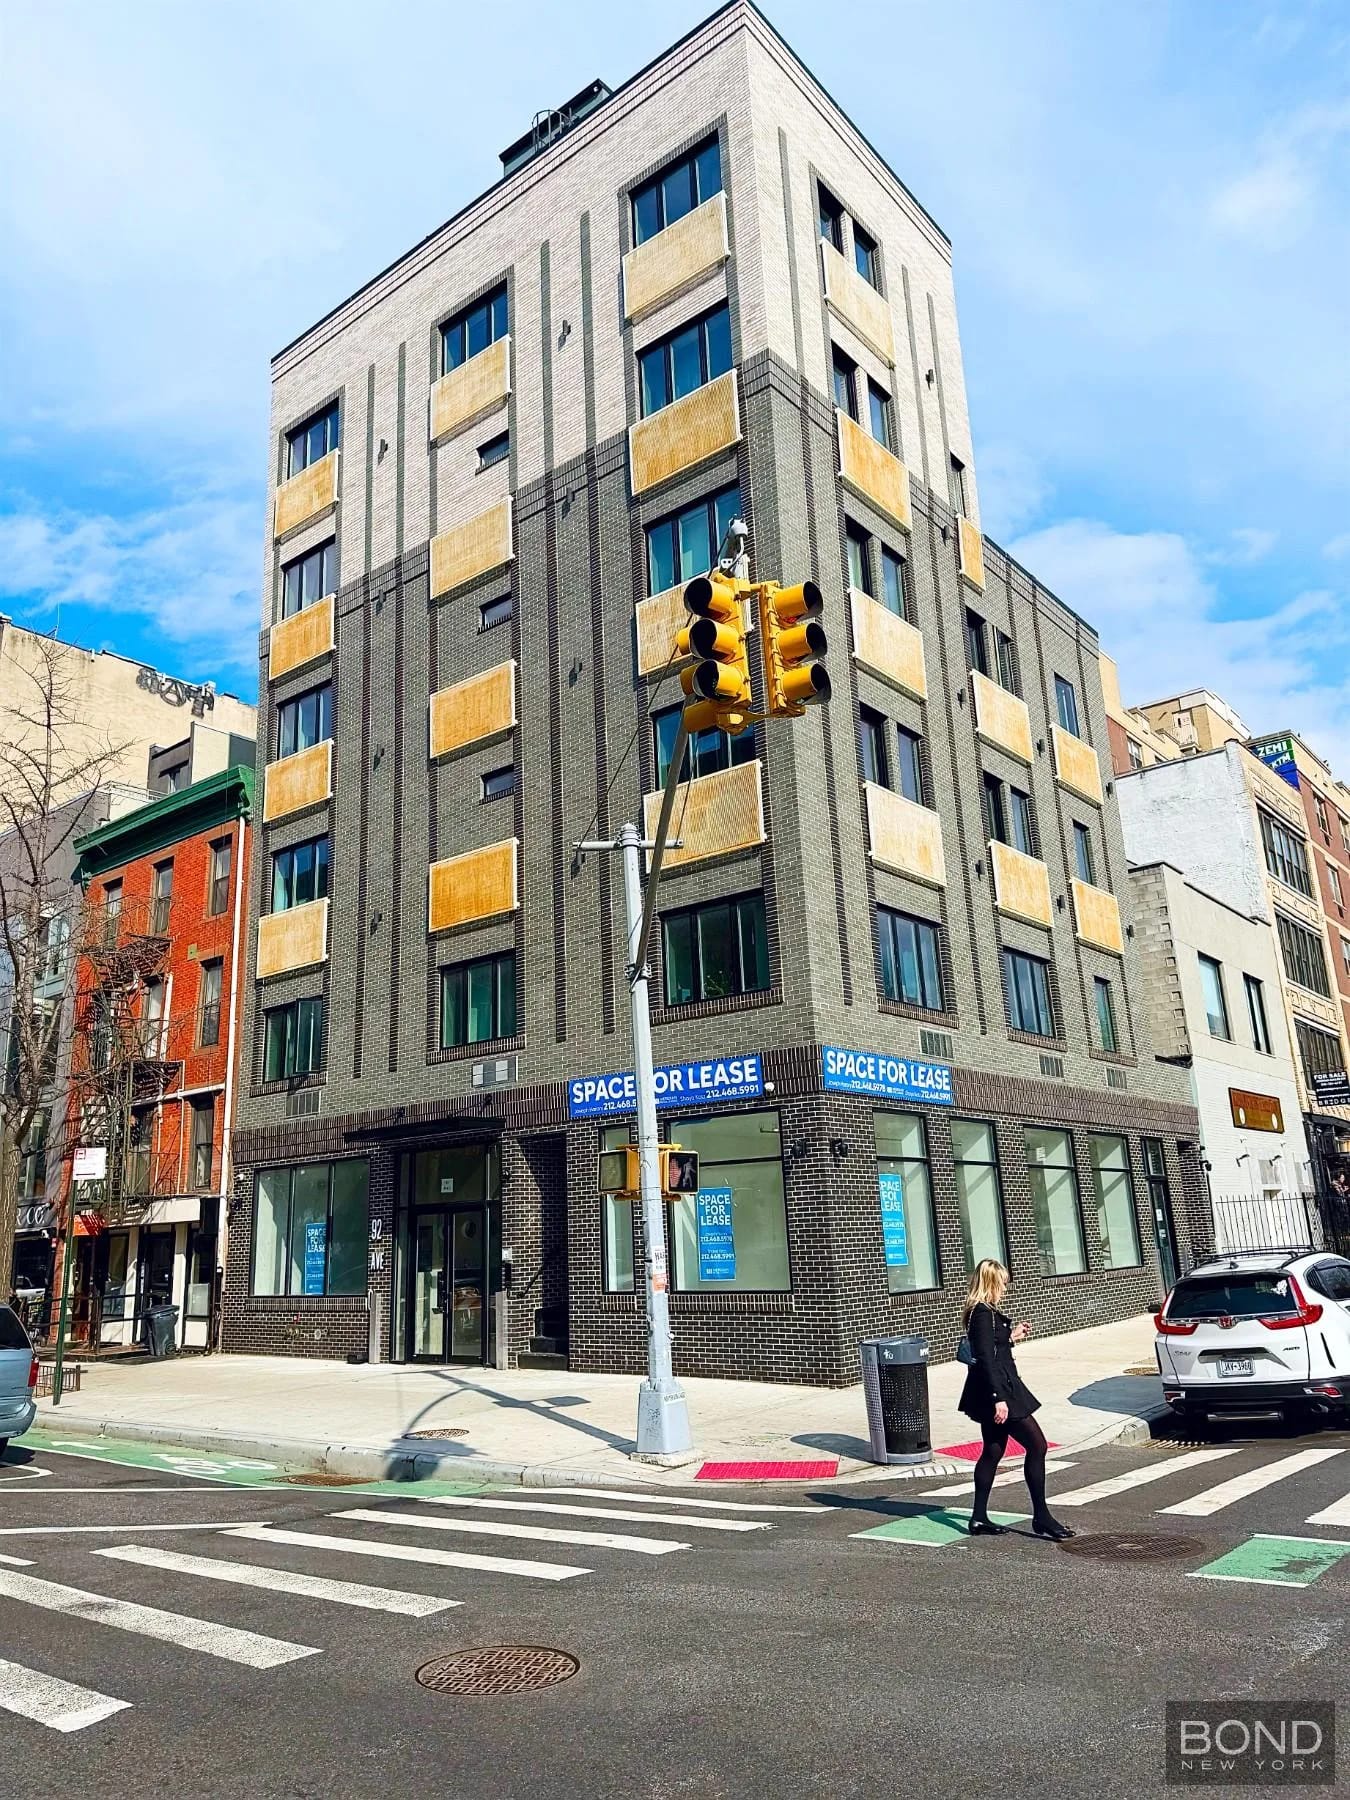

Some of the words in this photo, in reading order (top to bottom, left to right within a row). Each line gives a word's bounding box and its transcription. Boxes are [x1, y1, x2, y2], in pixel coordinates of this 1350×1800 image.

[826, 1050, 876, 1080] SPACE
[878, 1058, 909, 1086] FOR
[910, 1064, 951, 1091] LEASE
[572, 1075, 636, 1104] SPACE
[653, 1070, 684, 1094] OR
[687, 1058, 758, 1090] LEASE
[705, 1084, 759, 1099] 212.468.5991
[699, 1194, 731, 1206] SPACE
[705, 1205, 726, 1215] FOR
[700, 1215, 731, 1226] LEASE
[307, 1228, 327, 1237] SPACE
[371, 1218, 382, 1240] 92
[370, 1251, 384, 1270] AVE
